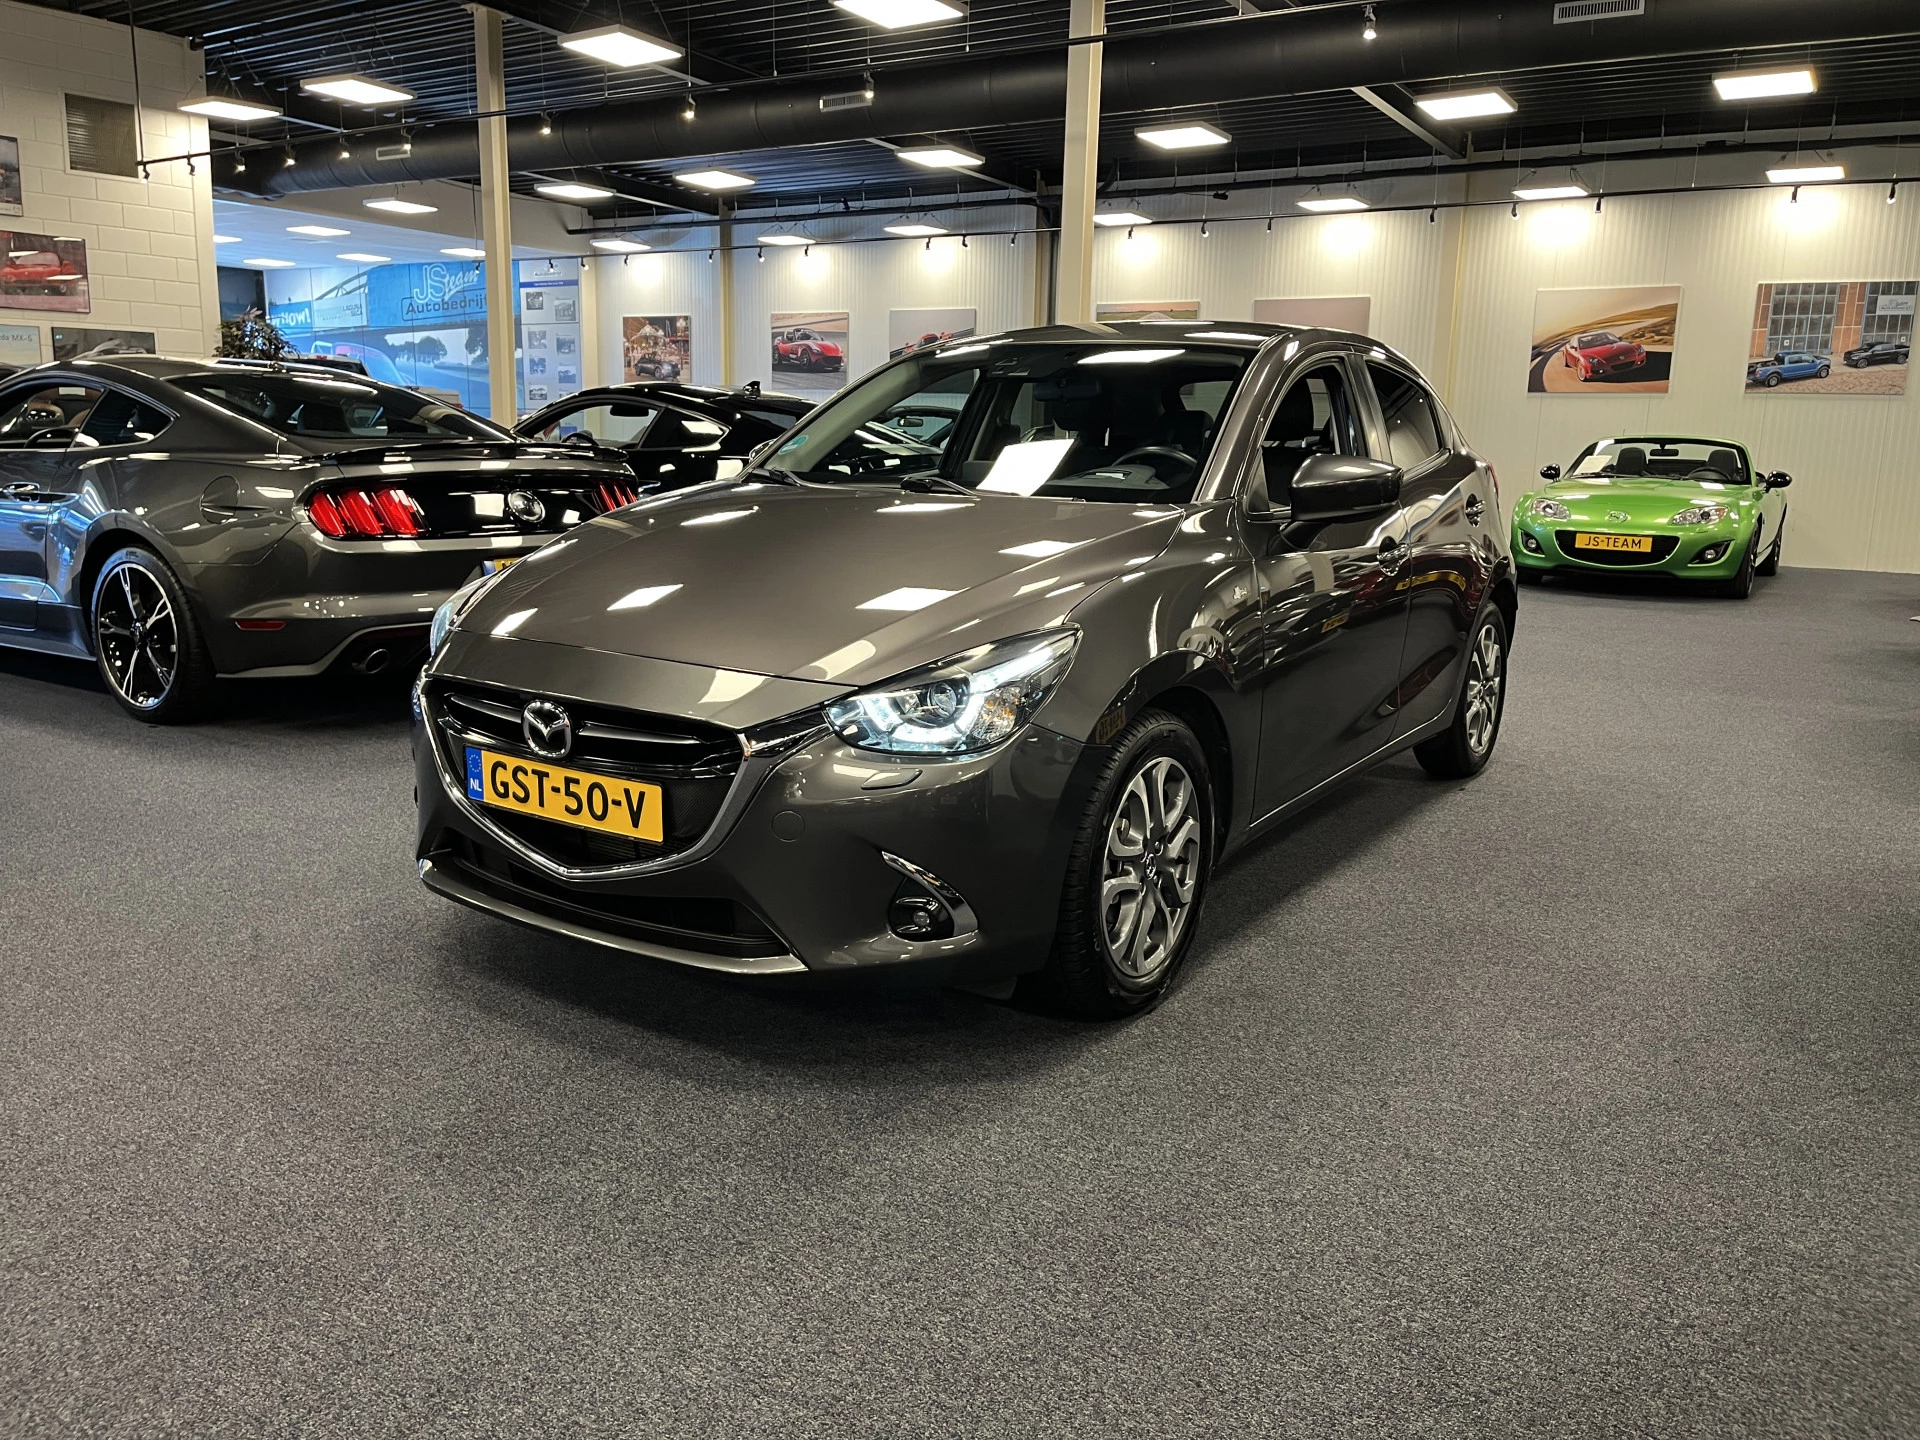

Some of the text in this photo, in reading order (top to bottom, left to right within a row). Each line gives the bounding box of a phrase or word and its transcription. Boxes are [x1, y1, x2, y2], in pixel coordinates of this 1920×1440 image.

[1585, 535, 1642, 549] JS-TEAM
[470, 777, 482, 792] NL
[490, 760, 646, 829] GST-50-V
